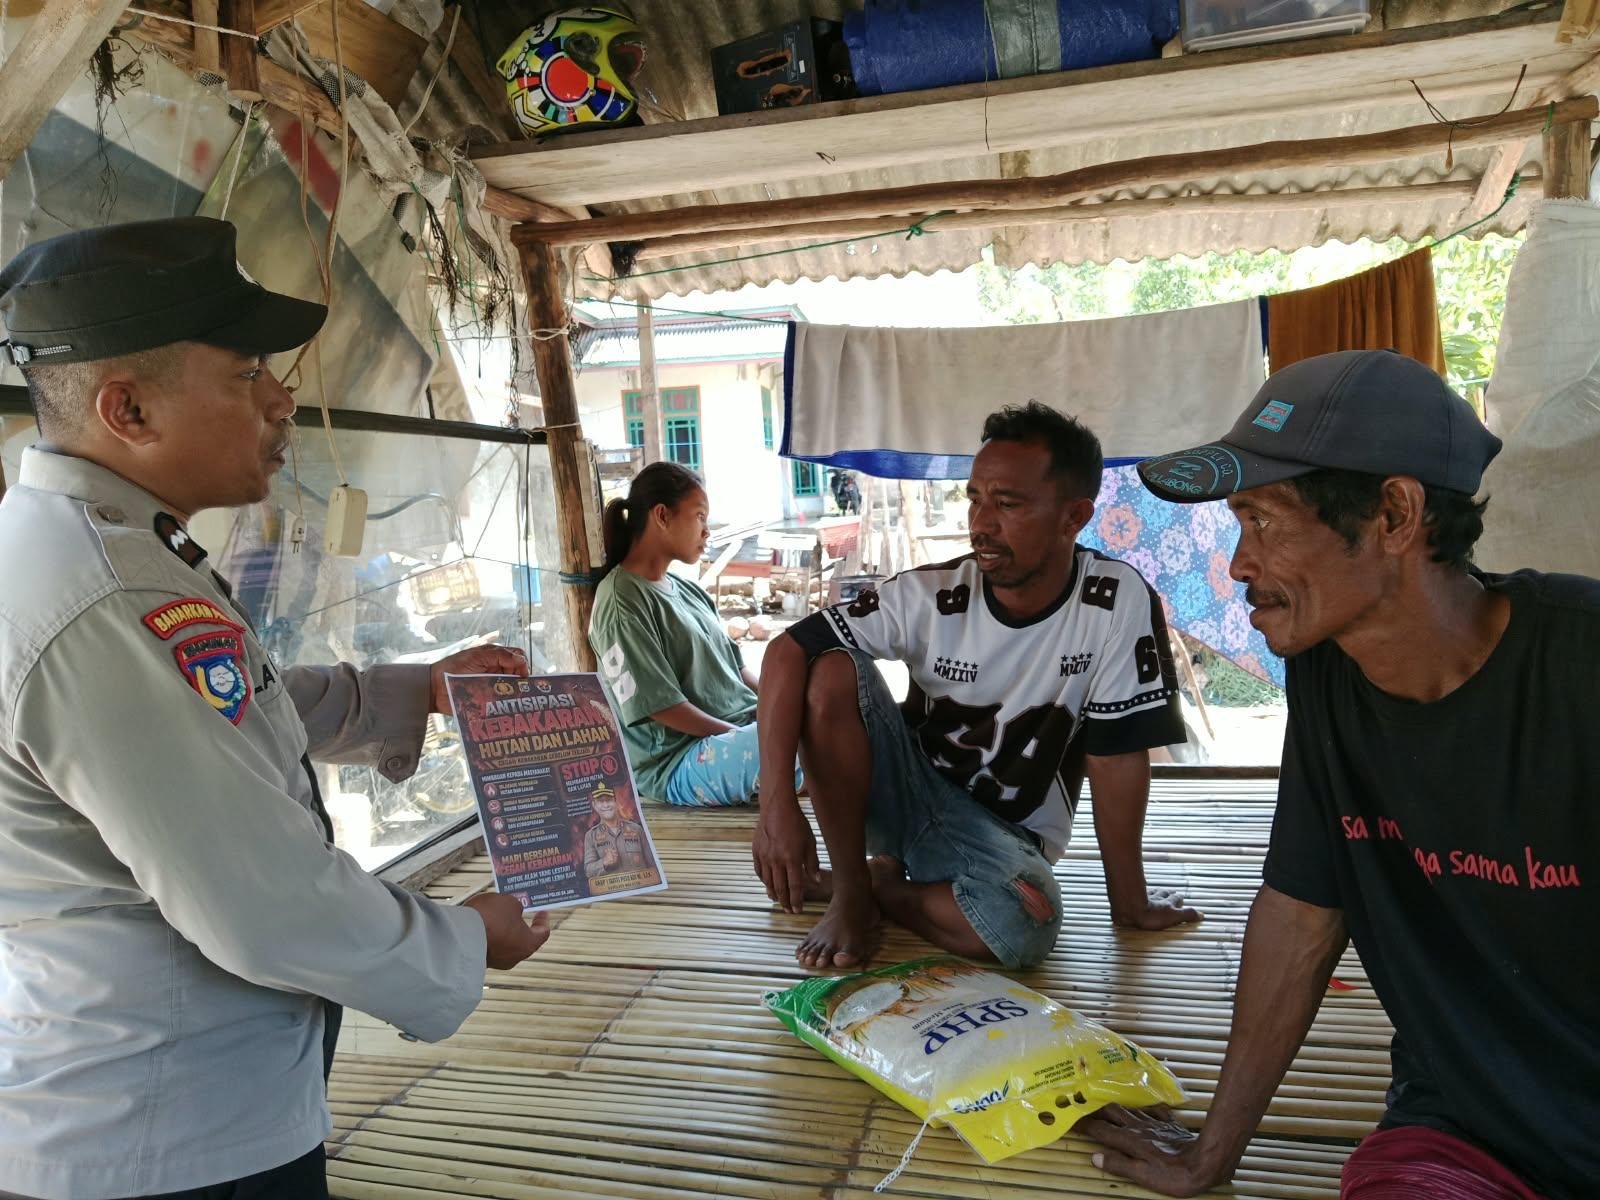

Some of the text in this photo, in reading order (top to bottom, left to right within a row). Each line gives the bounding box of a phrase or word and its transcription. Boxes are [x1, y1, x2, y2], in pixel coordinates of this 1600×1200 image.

[934, 662, 978, 683] MMXXIV
[486, 693, 576, 717] ANTISIPASI
[469, 706, 606, 741] KEBAKARAN
[478, 725, 611, 760] HUTAN DAN LAHAN
[561, 757, 600, 780] STOP
[501, 846, 560, 864] MARI BERSAMA
[527, 853, 573, 869] KEBAKARAN
[1341, 816, 1368, 839] sa
[1449, 850, 1519, 887] sama
[1524, 846, 1580, 890] kau
[921, 1000, 1029, 1055] SPHP
